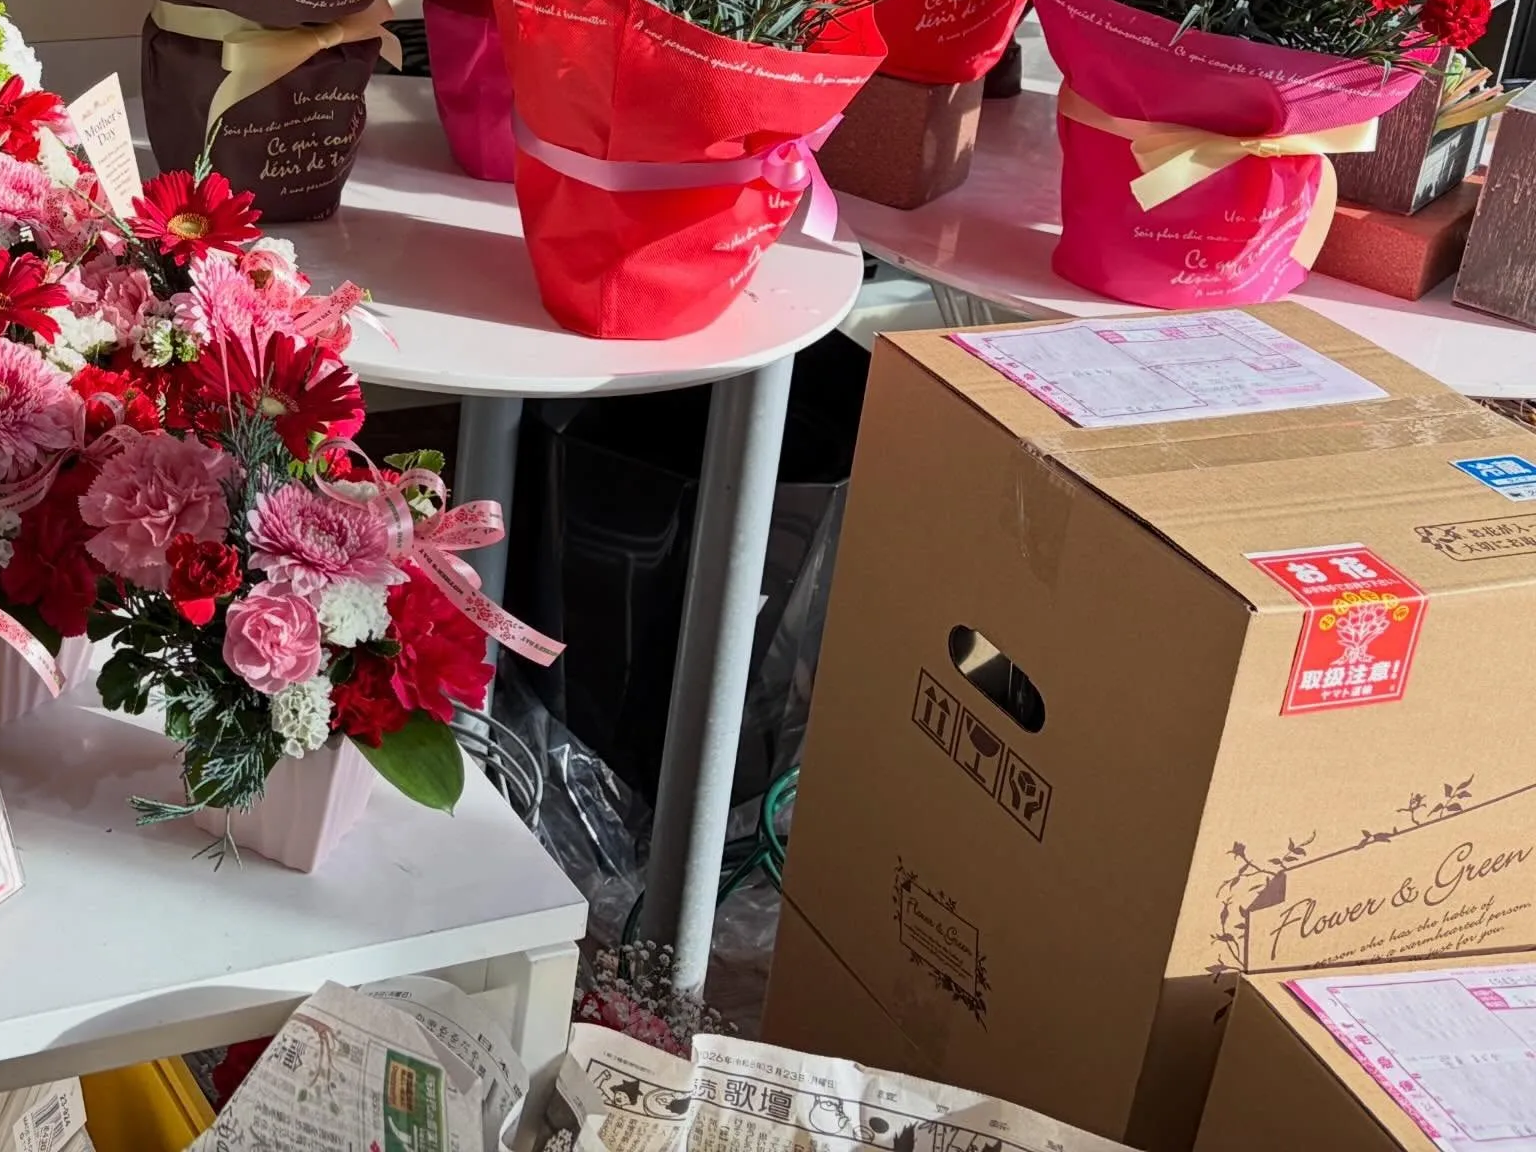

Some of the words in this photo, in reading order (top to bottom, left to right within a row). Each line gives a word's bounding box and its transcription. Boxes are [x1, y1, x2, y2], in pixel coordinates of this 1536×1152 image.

[1174, 46, 1186, 57] Ce
[1189, 52, 1207, 63] qui
[1207, 58, 1246, 73] compte
[293, 92, 311, 105] Un
[314, 87, 358, 101] cadeau
[84, 109, 122, 141] Mother's
[98, 129, 116, 146] Day
[243, 123, 263, 137] plus
[268, 137, 287, 156] Ce
[292, 133, 319, 159] qui
[260, 159, 301, 180] désir
[307, 151, 326, 172] de
[1133, 226, 1154, 238] Sois
[1156, 228, 1179, 241] plus
[1182, 229, 1202, 241] chic
[1185, 249, 1209, 269] Ce
[1287, 556, 1377, 584] お花
[1299, 660, 1400, 690] 取扱注意!
[1321, 686, 1373, 700] ヤマト運輸
[1270, 897, 1386, 960] Flower
[1391, 877, 1419, 908] &
[1424, 841, 1534, 906] Green
[1360, 936, 1384, 953] who
[1389, 927, 1414, 942] has
[1415, 919, 1437, 934] the
[1442, 904, 1474, 925] habit
[1476, 896, 1495, 914] of
[1399, 914, 1485, 953] warmhearted
[1455, 934, 1478, 951] for
